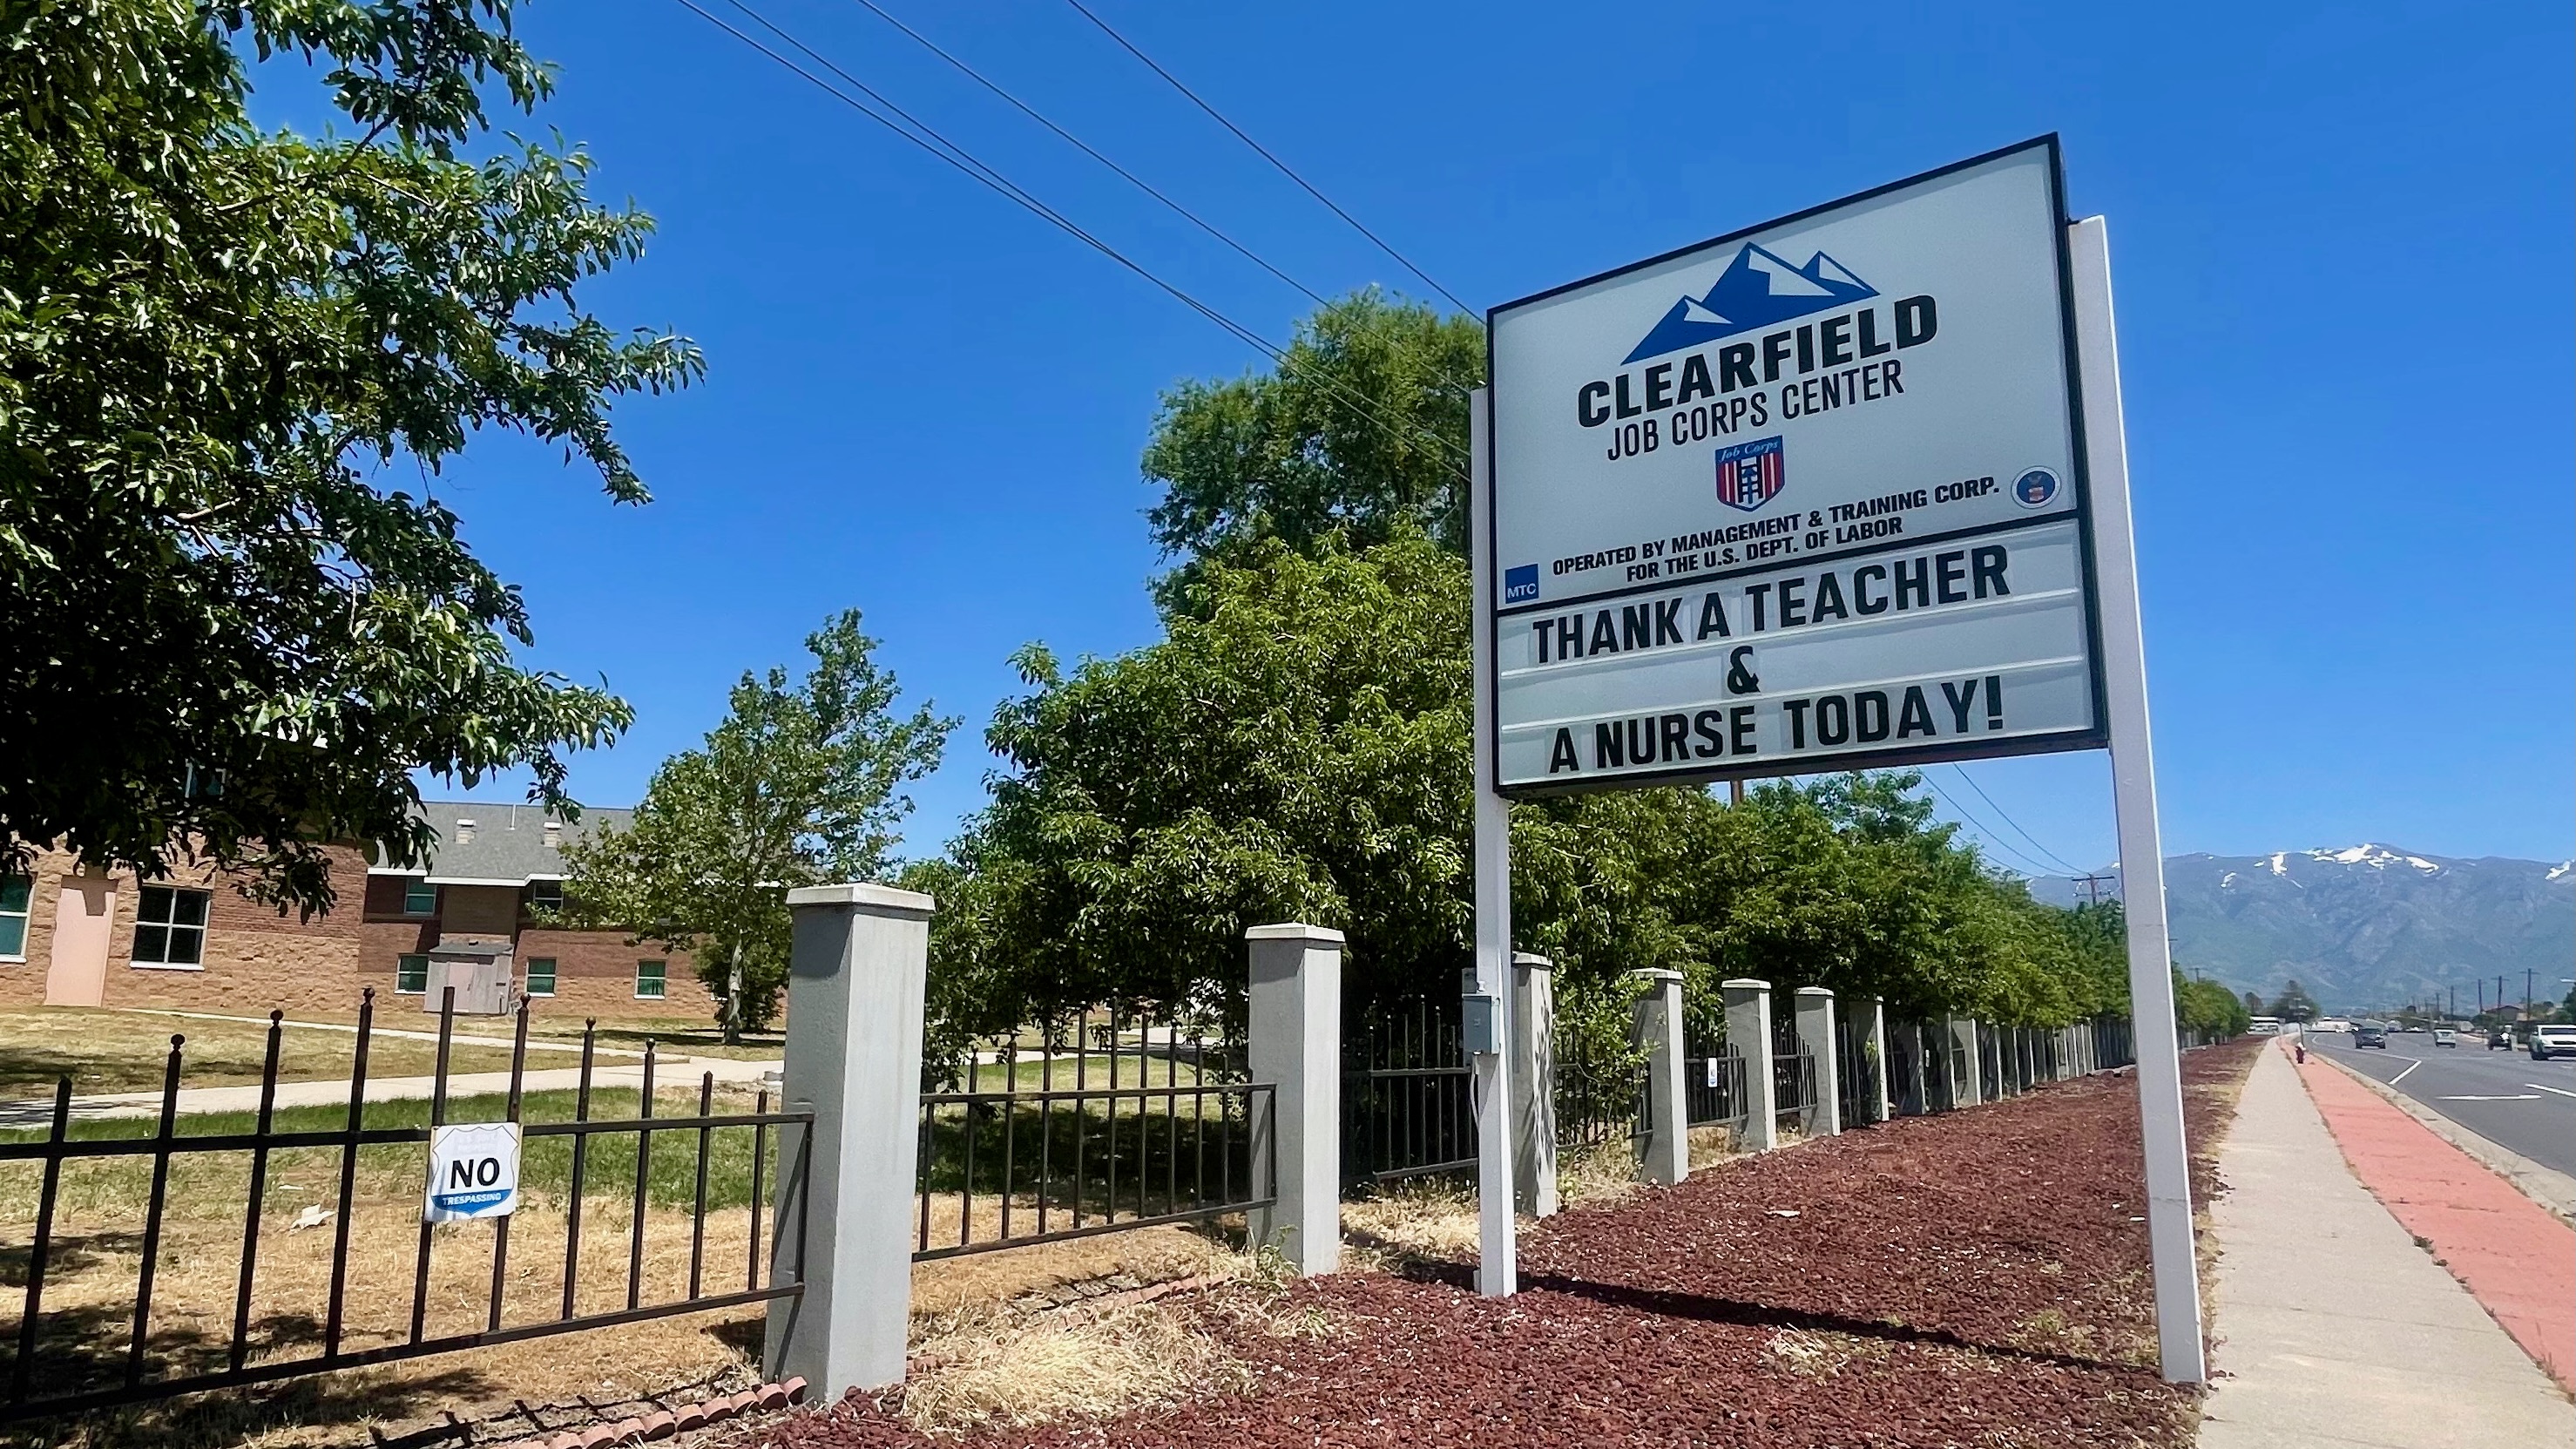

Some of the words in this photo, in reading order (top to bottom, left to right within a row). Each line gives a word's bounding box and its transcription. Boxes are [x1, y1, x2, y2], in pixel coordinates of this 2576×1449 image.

[1578, 295, 1937, 427] CLEARFIELD
[1608, 418, 1659, 461] JOB
[1672, 392, 1768, 446] CORPS
[1782, 359, 1904, 420] CENTER
[1719, 446, 1740, 463] Job
[1745, 441, 1778, 454] Corps
[1552, 545, 1636, 576] OPERATED
[1643, 540, 1665, 559] BY
[1672, 513, 1801, 554] MANAGEMENT
[1808, 510, 1823, 528] &
[1829, 490, 1927, 524] TRAINING
[1935, 477, 2000, 504] CORP.
[1626, 565, 1660, 582] FOR
[1665, 558, 1698, 575] THE
[1704, 547, 1741, 567] U.S.
[1746, 536, 1799, 561] DEPT.
[1805, 529, 1829, 550] OF
[1836, 516, 1903, 545] LABOR
[1507, 583, 1537, 599] MTC
[1532, 597, 1683, 664] THANK
[1697, 592, 1730, 640] A
[1744, 544, 2011, 632] TEACHER
[1727, 646, 1761, 694] &
[1549, 727, 1579, 774] A
[1595, 704, 1758, 769] NURSE
[1782, 674, 2005, 749] TODAY!
[442, 1192, 502, 1206] TRESPASSING
[450, 1157, 500, 1189] NO
